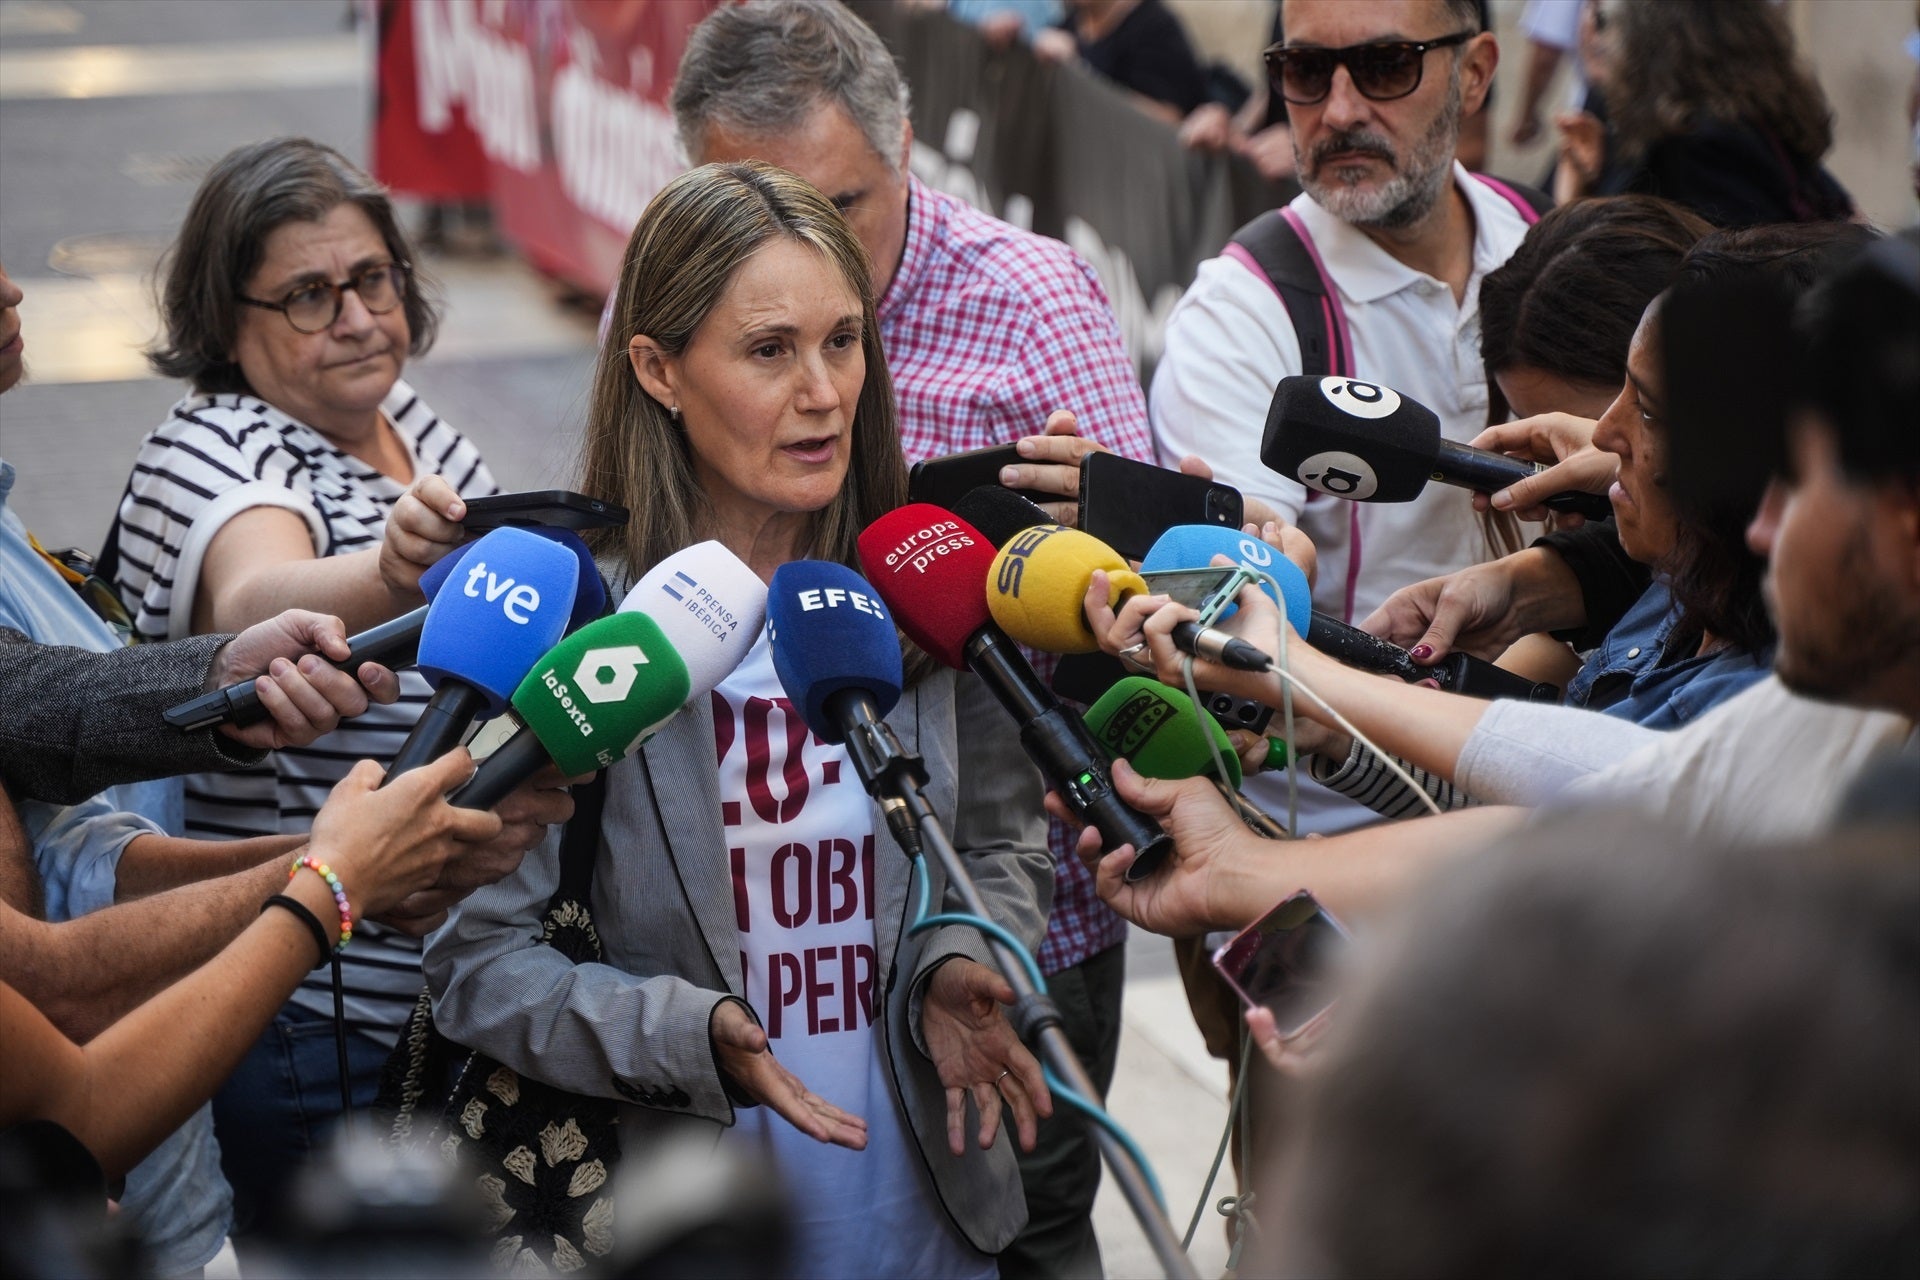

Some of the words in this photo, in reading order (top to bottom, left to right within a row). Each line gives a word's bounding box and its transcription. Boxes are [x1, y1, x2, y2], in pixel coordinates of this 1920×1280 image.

[885, 521, 960, 566] europa
[912, 536, 975, 574] press
[463, 562, 541, 625] tve
[696, 587, 738, 631] PRENSA
[684, 599, 727, 642] IBÉRICA
[541, 668, 594, 737] laSexta
[1124, 706, 1162, 746] CERO
[768, 944, 882, 1039] PER
